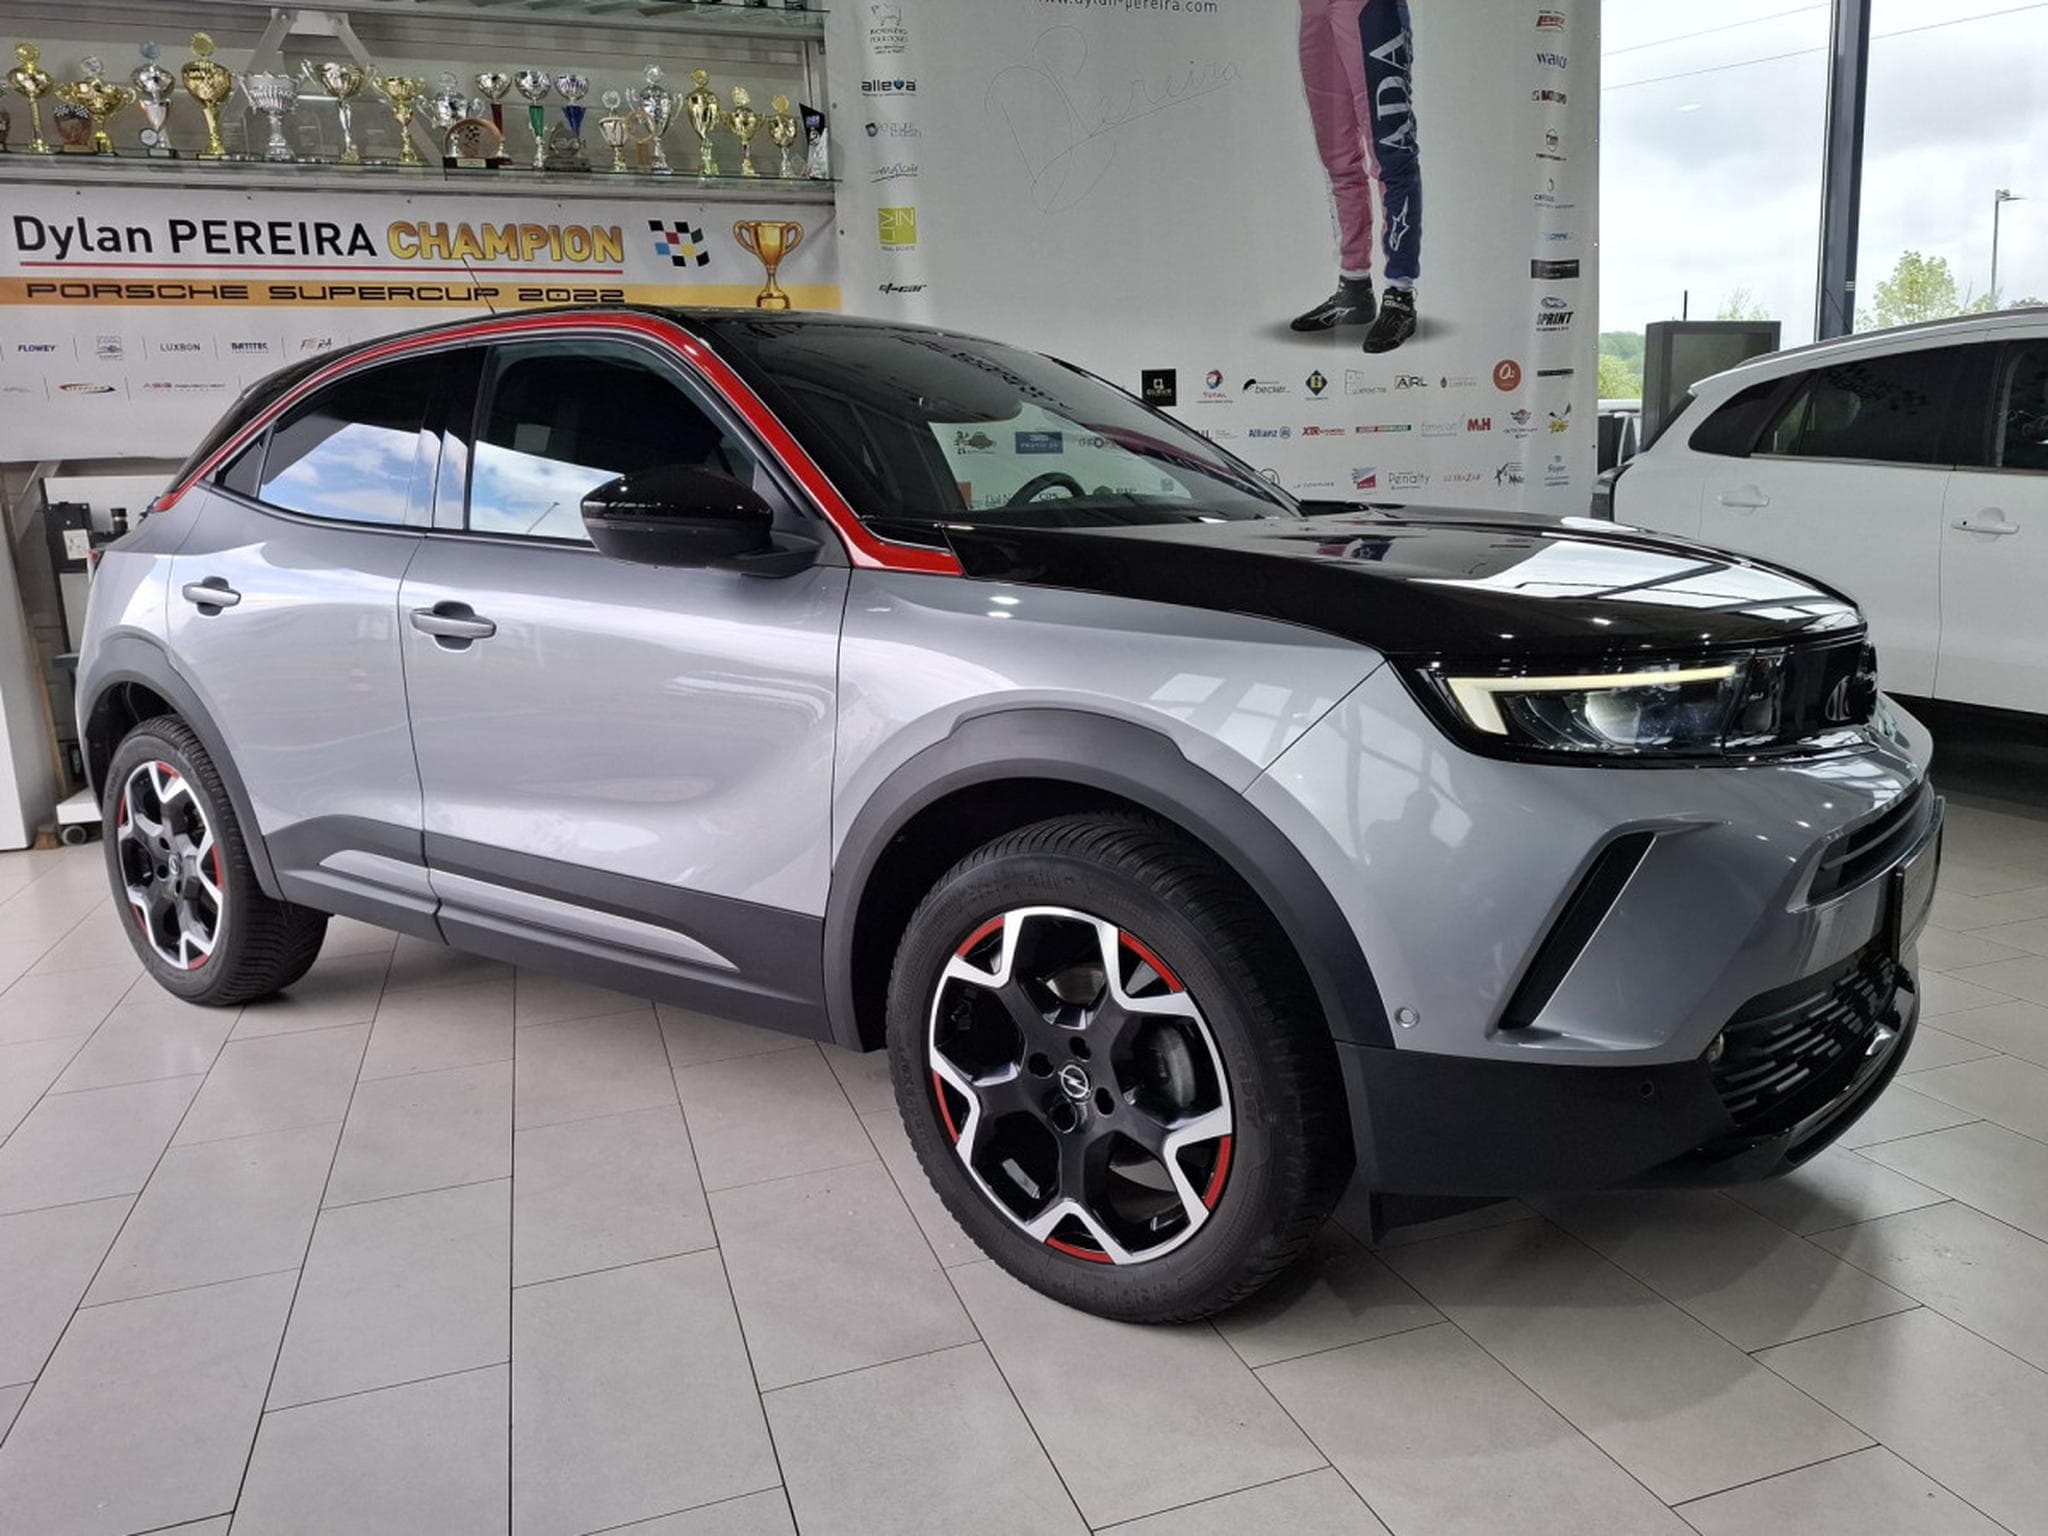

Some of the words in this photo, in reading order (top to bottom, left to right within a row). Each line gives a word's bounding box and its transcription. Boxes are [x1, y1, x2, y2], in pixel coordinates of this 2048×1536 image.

[13, 215, 153, 260] Dylan
[168, 218, 378, 257] PEREIRA
[386, 219, 625, 263] CHAMPION
[26, 283, 249, 300] PORSCHE
[269, 285, 500, 301] SUPERCUP
[517, 287, 625, 303] 2022
[18, 344, 56, 353] FLOWEY
[1248, 428, 1278, 438] Allianz
